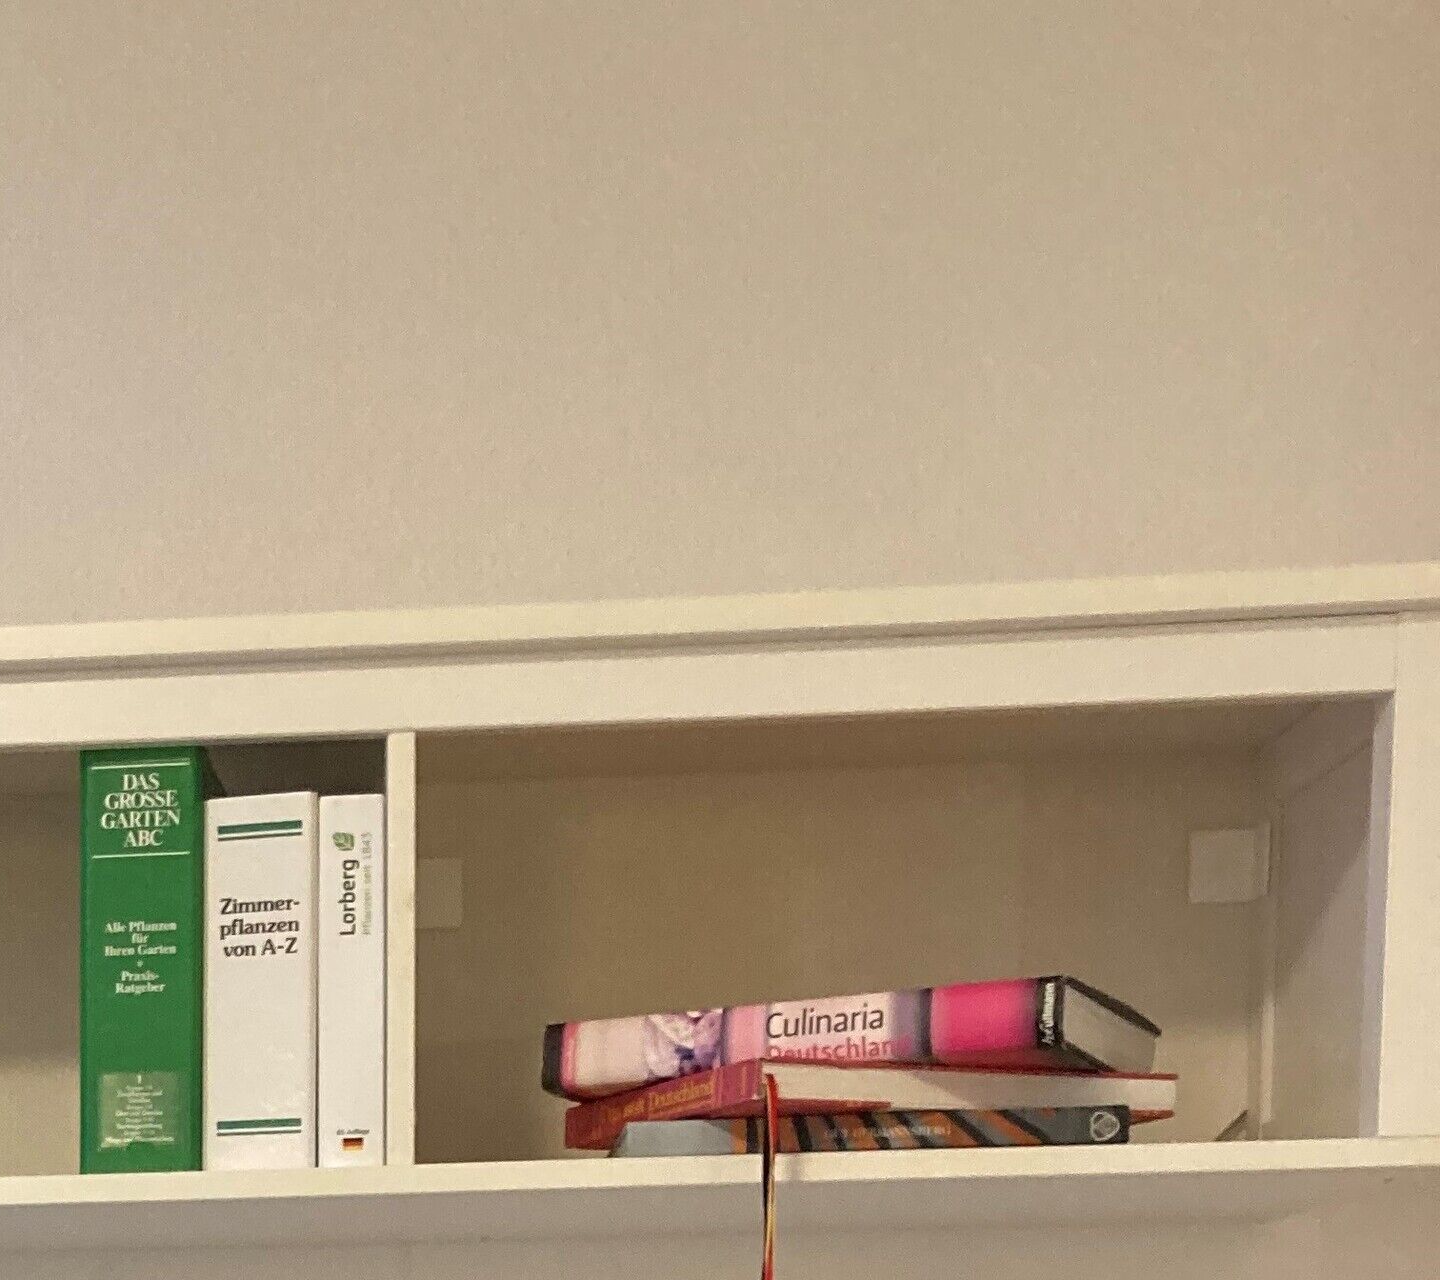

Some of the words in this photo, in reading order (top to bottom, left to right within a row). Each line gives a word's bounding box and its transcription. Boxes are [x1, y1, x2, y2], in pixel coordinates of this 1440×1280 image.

[123, 773, 160, 790] DAS
[104, 789, 179, 810] GROSSE
[101, 809, 181, 829] GARTEN
[124, 829, 164, 847] ABC
[219, 897, 300, 915] Zimmer-
[337, 859, 360, 936] Lorberg
[128, 920, 177, 932] Pflanzen
[220, 918, 300, 941] pflanzen
[105, 946, 135, 956] Ihren
[137, 944, 177, 955] Garten
[224, 944, 256, 957] von
[261, 937, 298, 956] A-Z
[115, 982, 166, 996] Ratgeber
[765, 1001, 885, 1039] Culinaria
